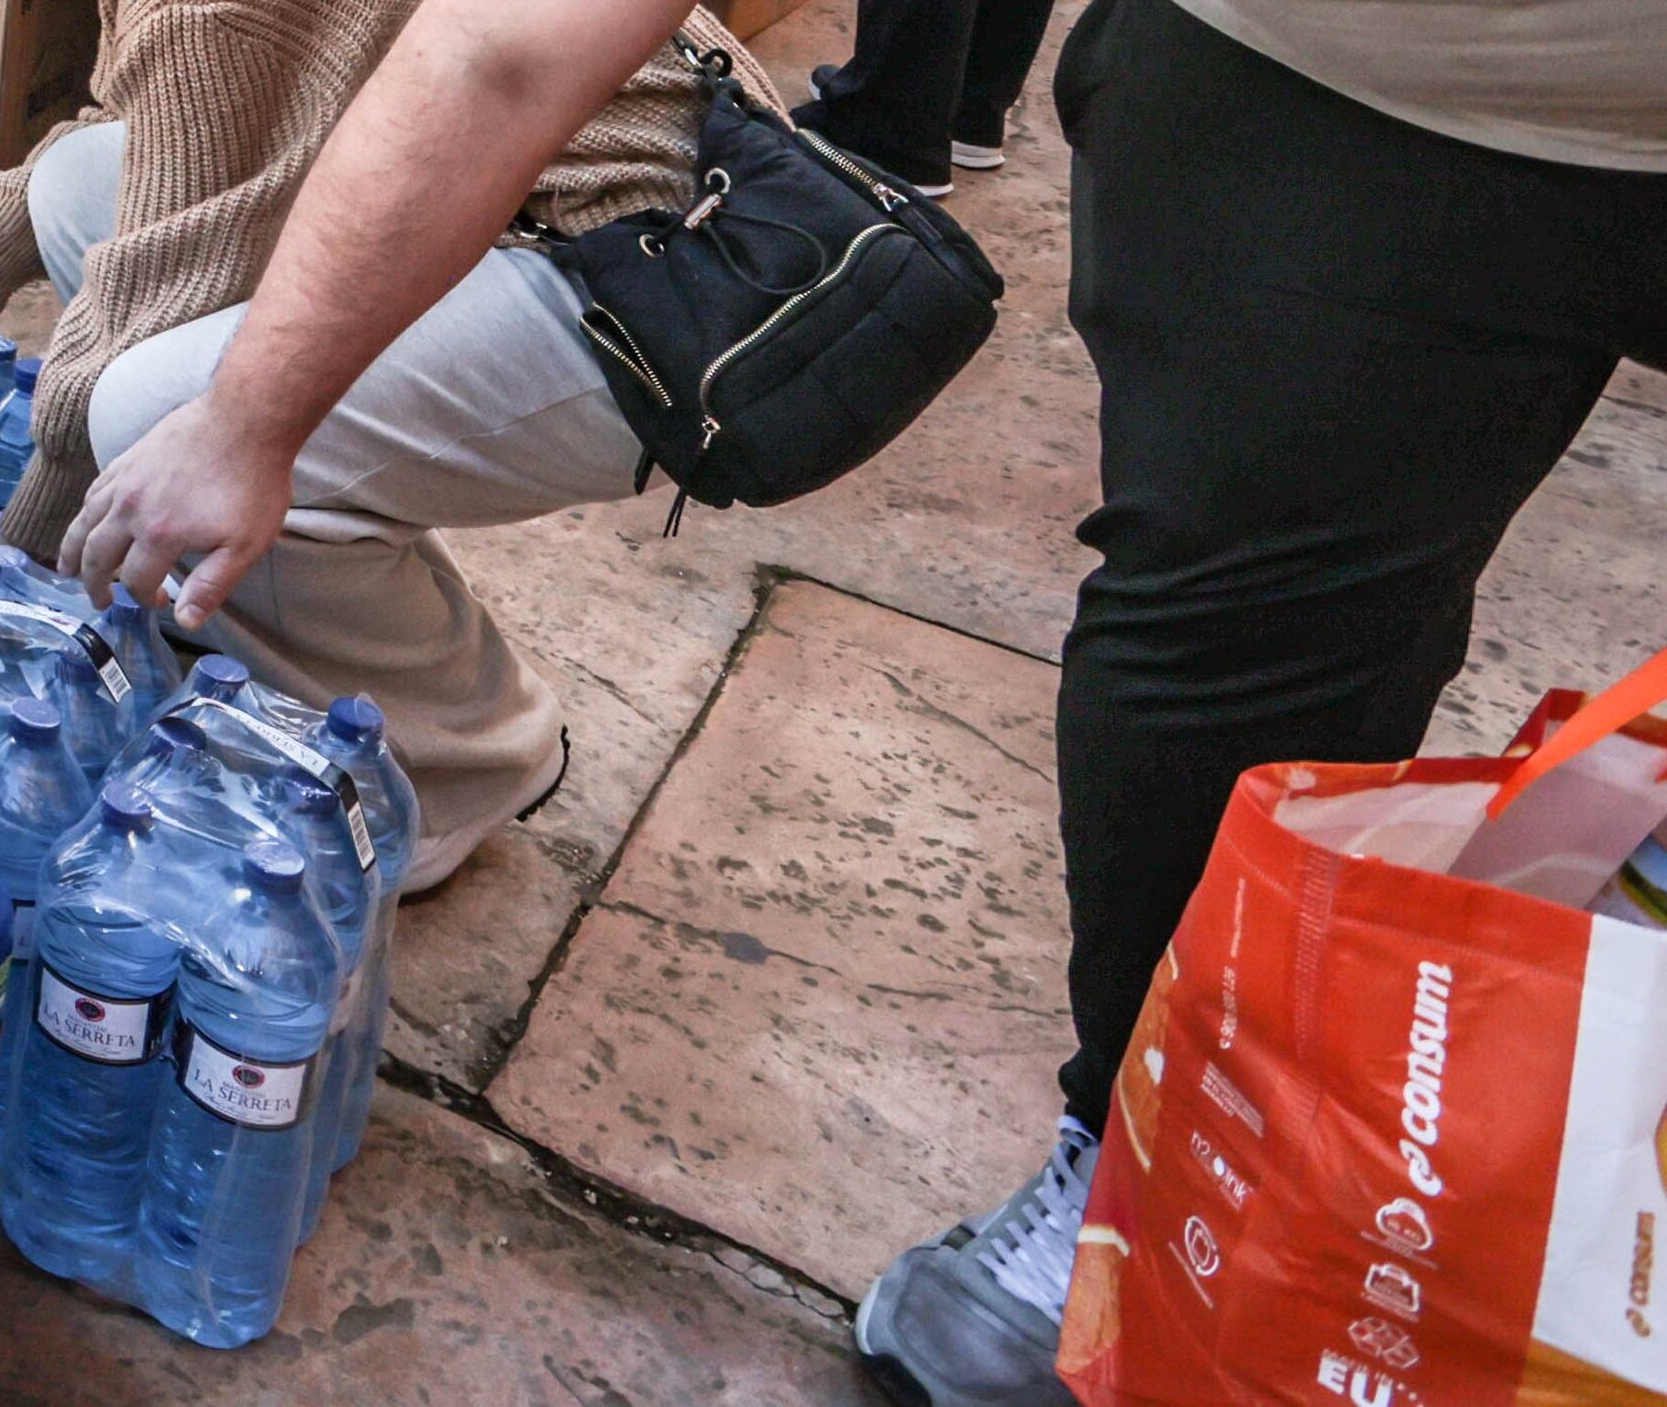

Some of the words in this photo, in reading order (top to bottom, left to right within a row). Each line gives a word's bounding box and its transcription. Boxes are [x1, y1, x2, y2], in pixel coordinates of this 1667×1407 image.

[44, 1002, 62, 1027] LA
[65, 1018, 136, 1048] SERRETA
[1399, 960, 1452, 1147] consum
[194, 1068, 214, 1094] LA
[217, 1084, 293, 1112] SERRETA
